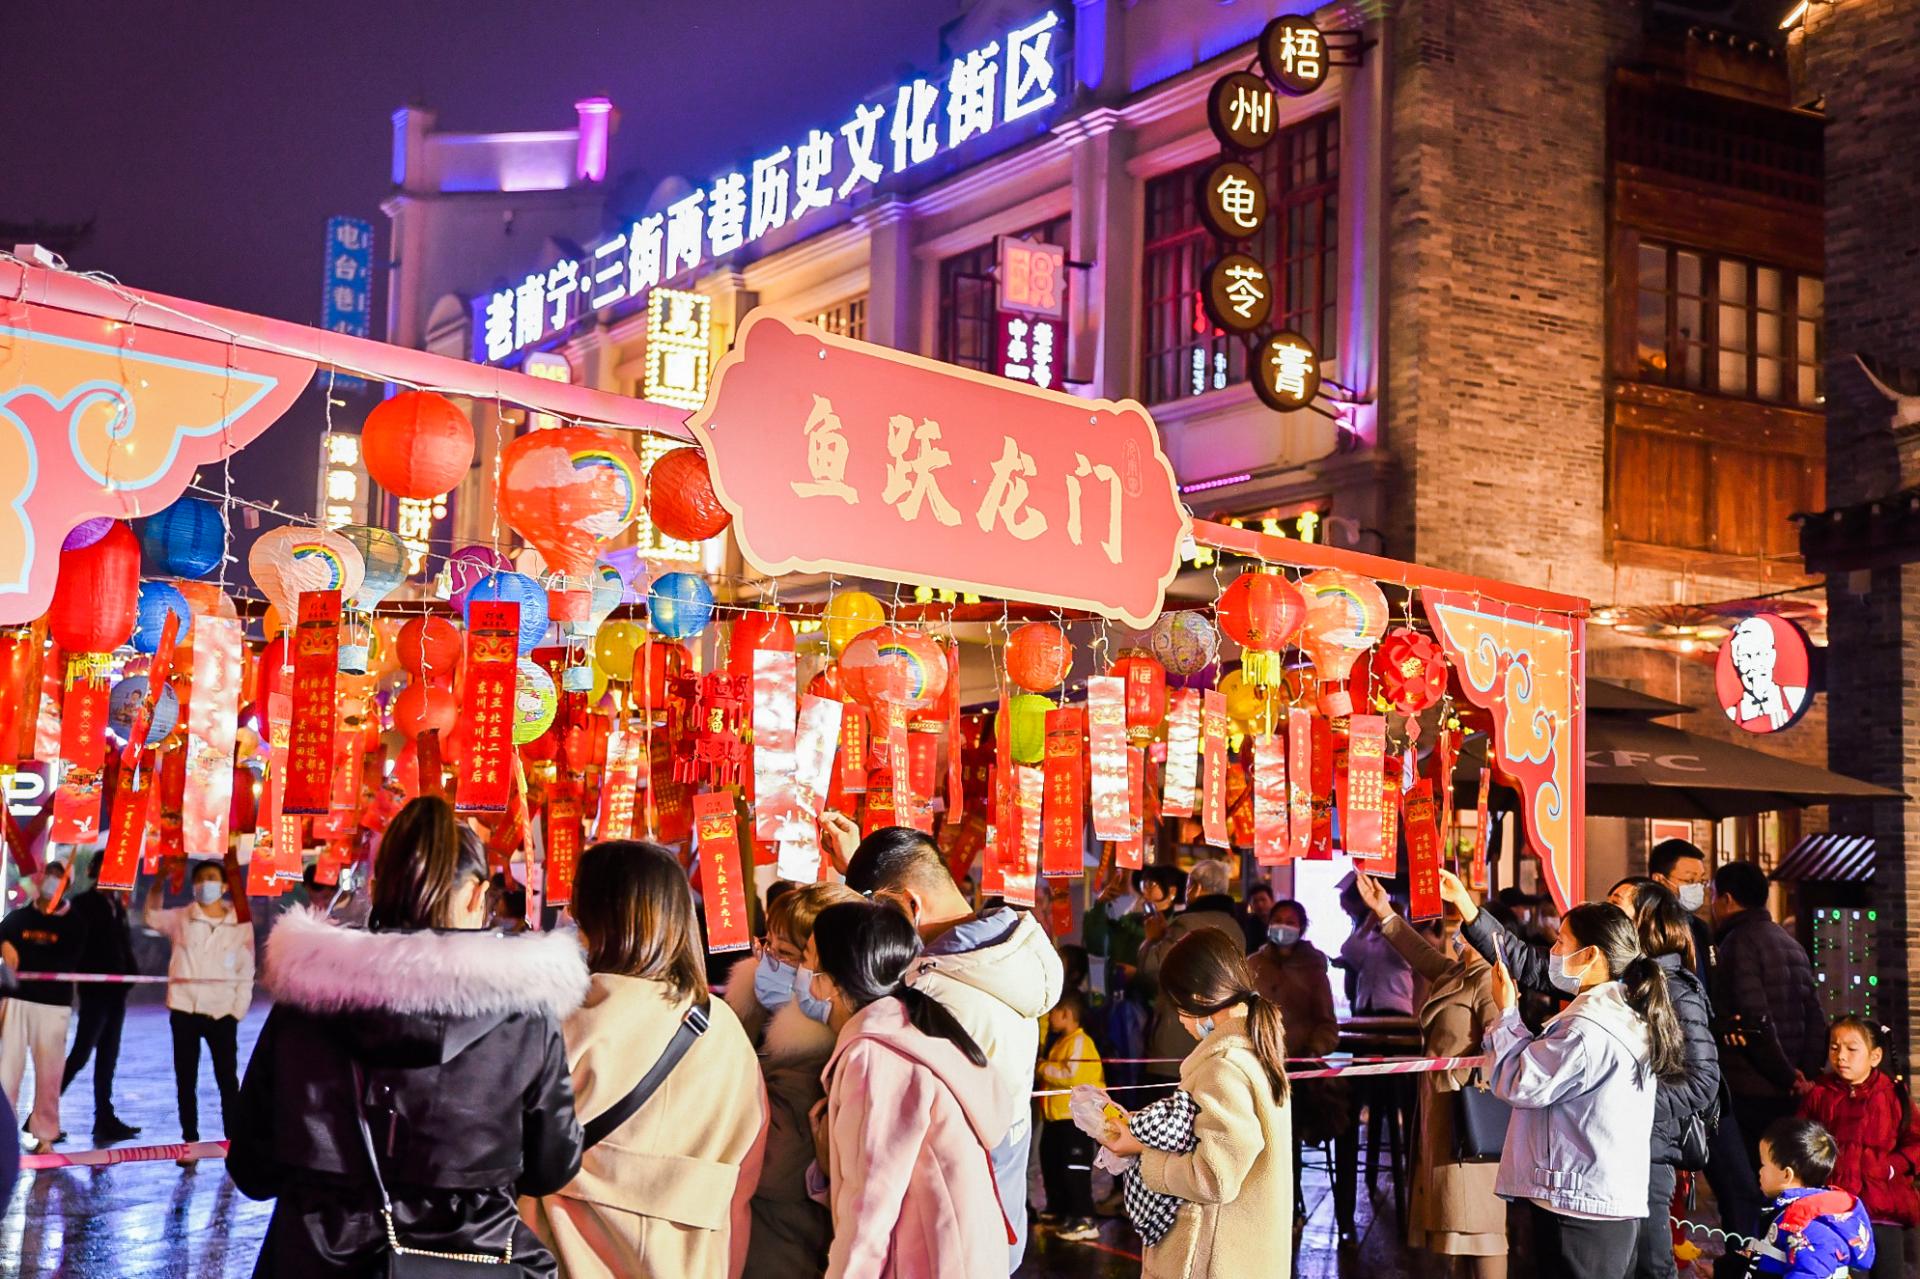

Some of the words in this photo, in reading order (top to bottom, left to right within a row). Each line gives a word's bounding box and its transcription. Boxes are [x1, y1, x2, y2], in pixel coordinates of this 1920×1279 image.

[1216, 27, 1321, 400] 梧州龟苓膏
[790, 394, 1124, 564] 鱼跃龙门
